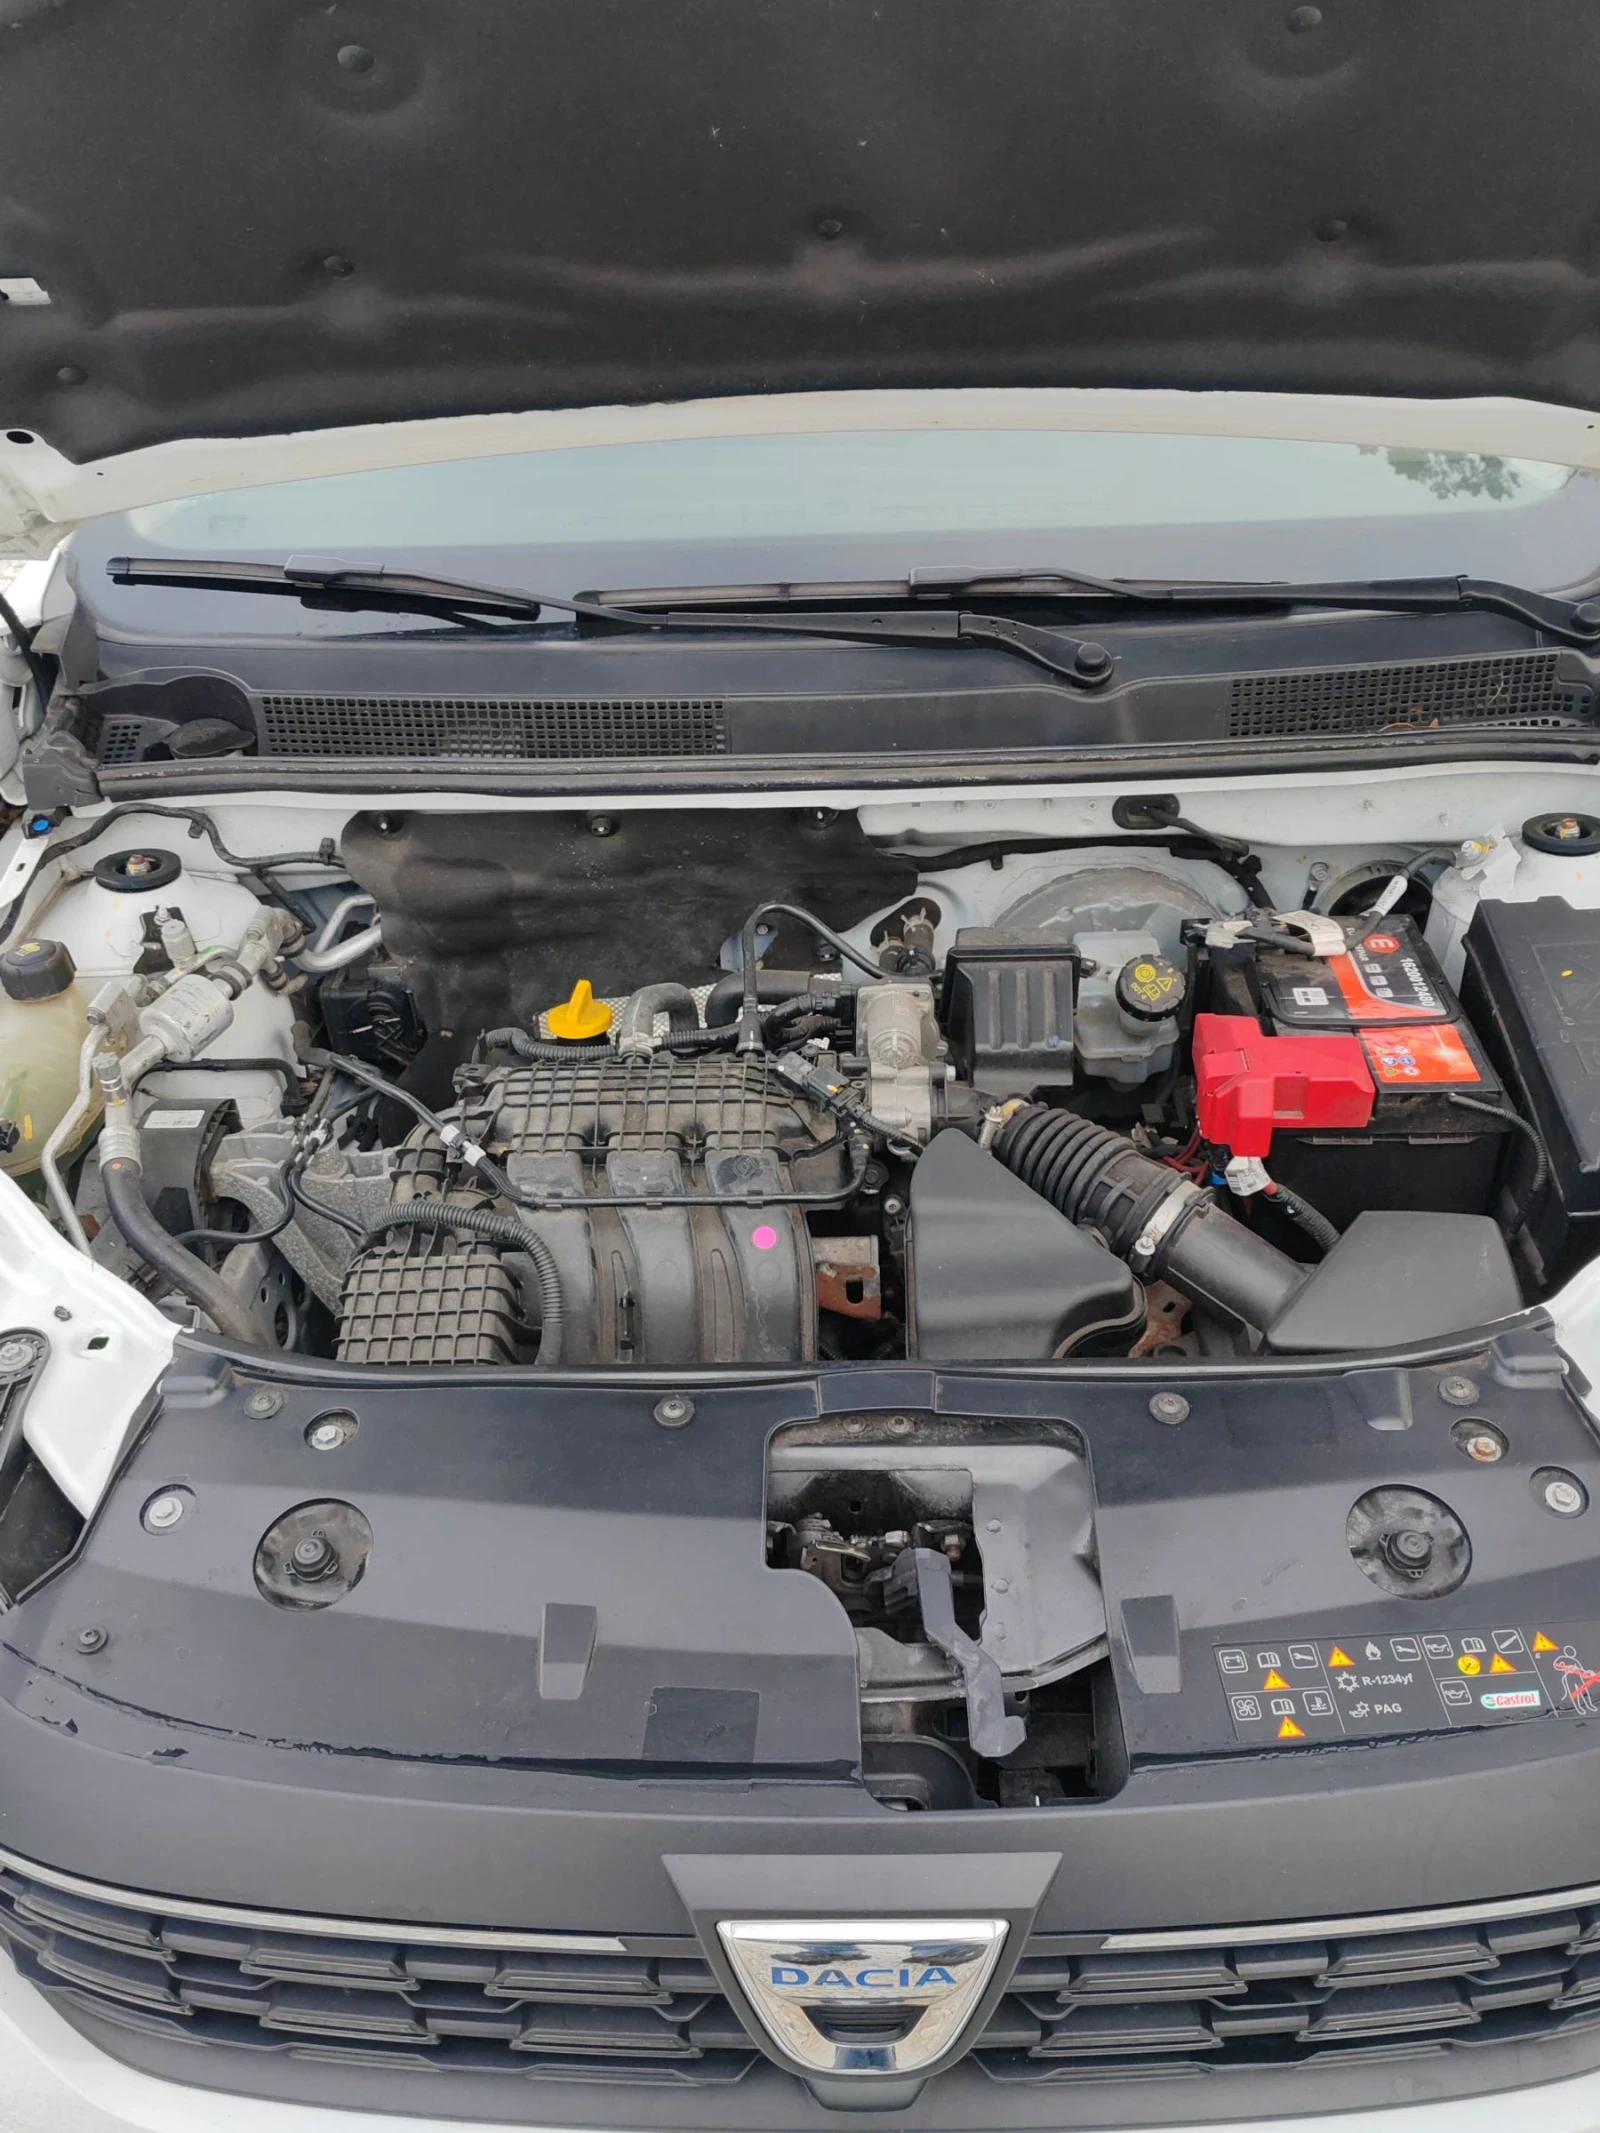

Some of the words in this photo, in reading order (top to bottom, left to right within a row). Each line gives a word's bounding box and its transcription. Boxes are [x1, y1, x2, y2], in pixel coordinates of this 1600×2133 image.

[1131, 982, 1143, 995] DOT
[1400, 957, 1436, 1007] 1620012480
[1362, 1673, 1414, 1687] R-1234yf
[1495, 1691, 1537, 1707] Castrol
[1374, 1703, 1402, 1714] PAG
[771, 1966, 957, 1989] DACIA
